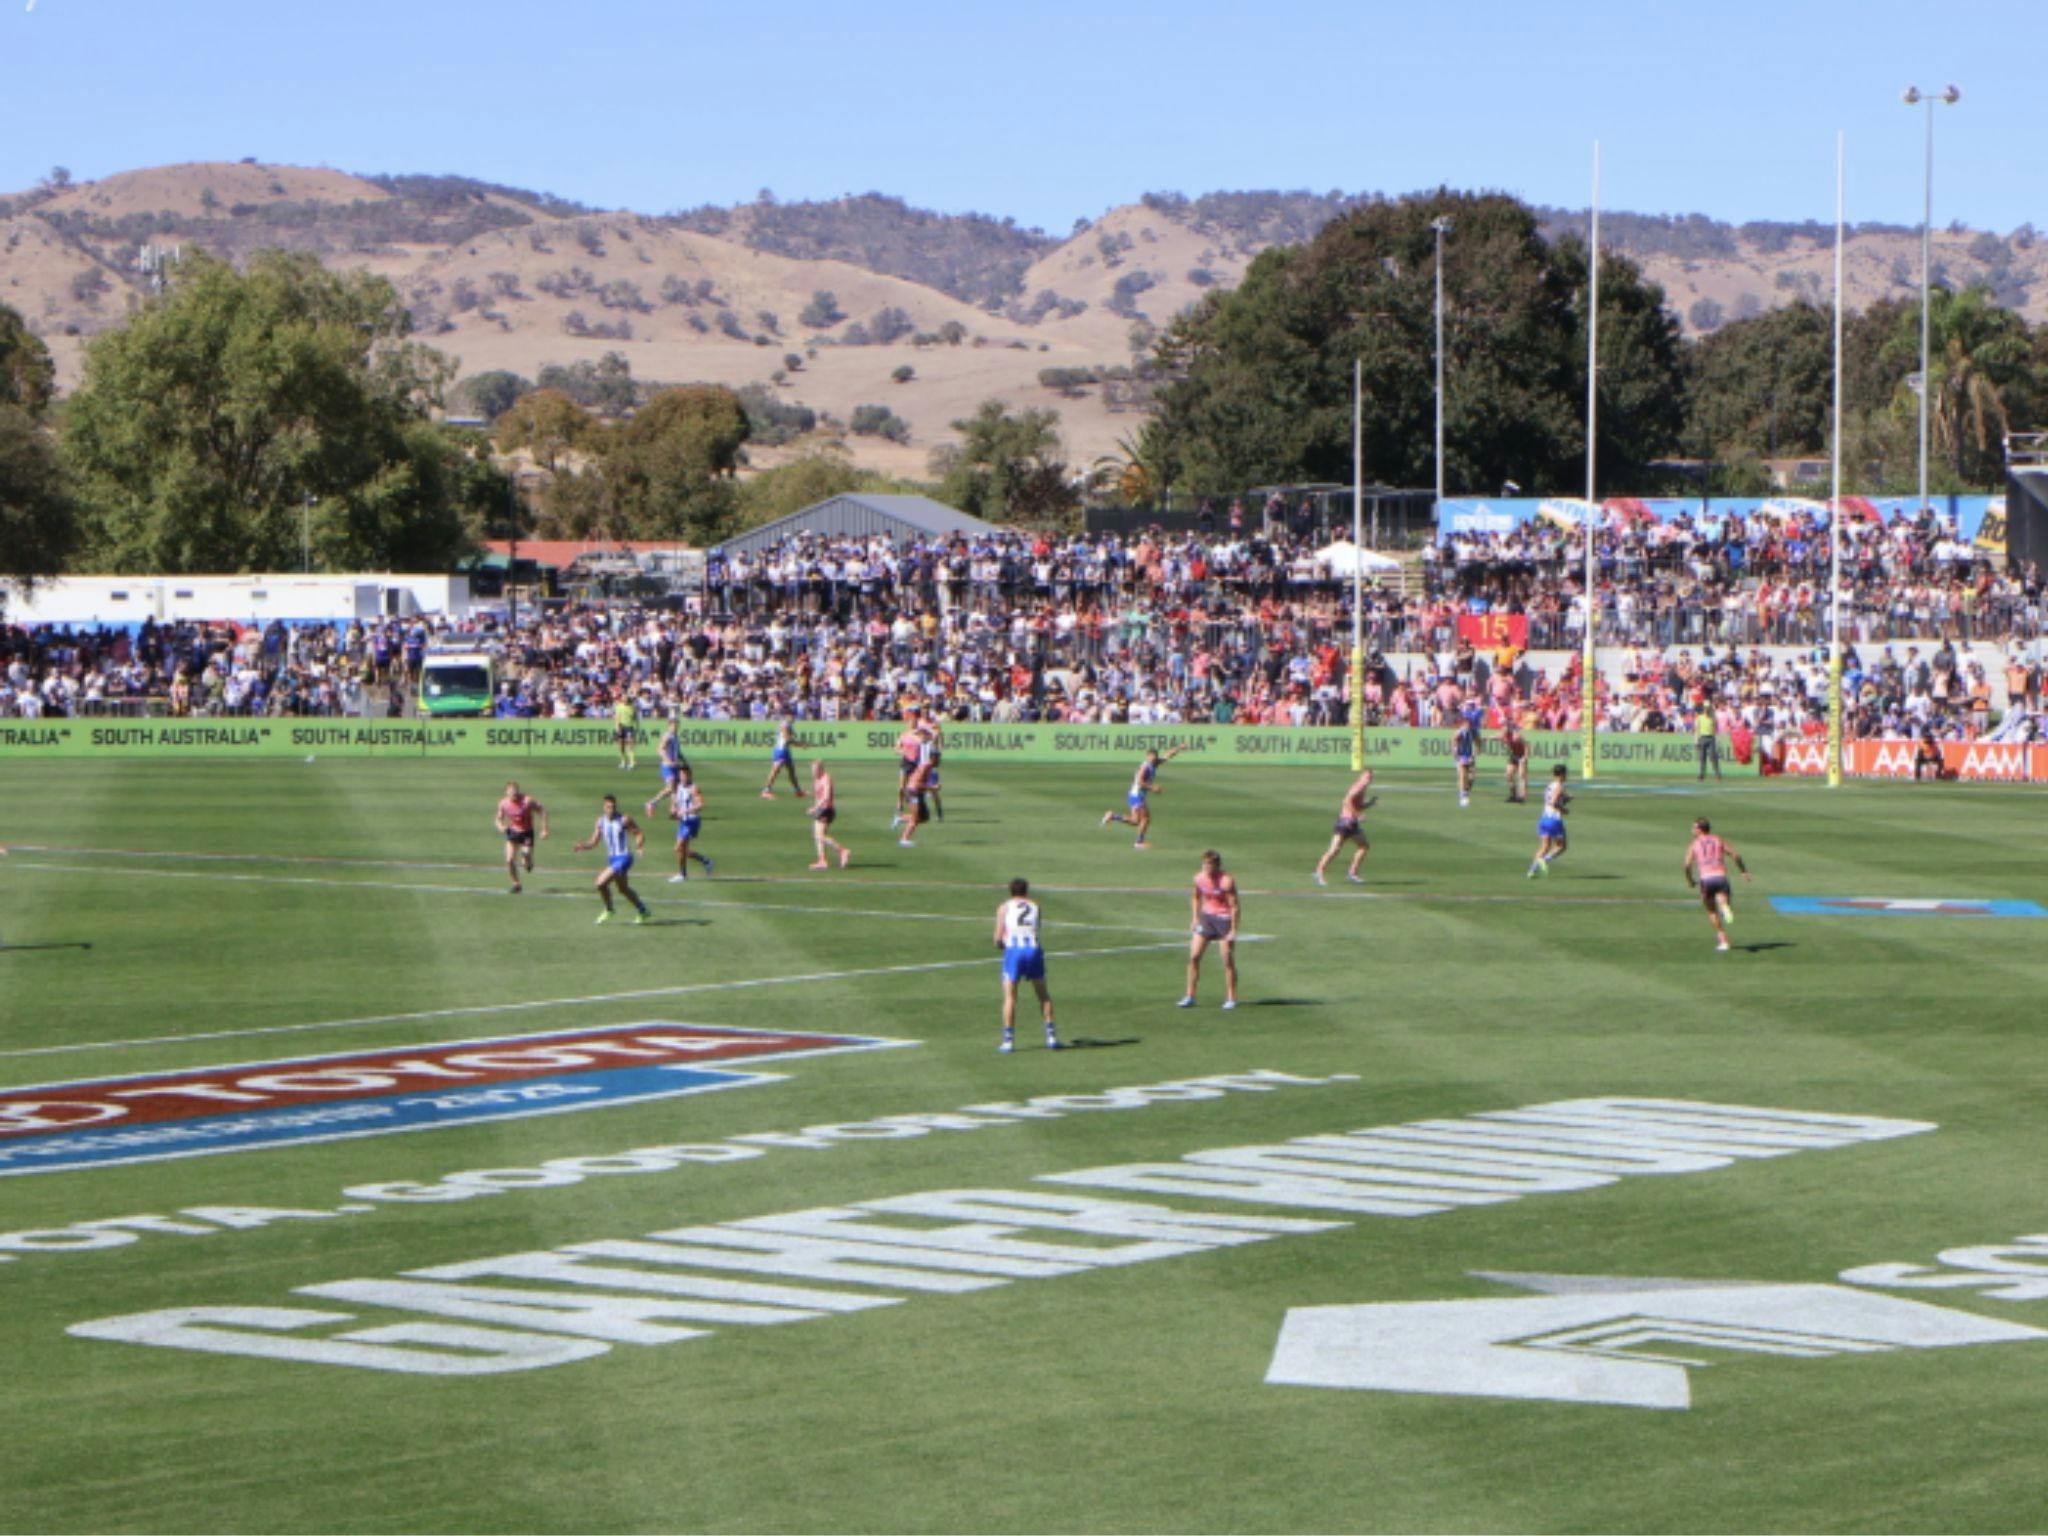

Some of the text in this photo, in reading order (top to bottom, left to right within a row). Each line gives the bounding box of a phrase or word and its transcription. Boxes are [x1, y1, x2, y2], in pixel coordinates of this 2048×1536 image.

[92, 728, 260, 745] SOUTH AUSTRALIA
[292, 728, 457, 746] SOUTH AUSTRALIA
[486, 728, 546, 745] SOUTH
[681, 729, 737, 746] SOUTH
[1054, 733, 1109, 750] SOUTH
[1235, 735, 1291, 753] SOUTH
[1600, 741, 1656, 761] SOUTH
[1016, 902, 1032, 926] 2
[104, 1036, 795, 1101] TOYOTA
[341, 1143, 767, 1203] GOOD
[723, 1112, 1026, 1149] FOR
[64, 1096, 1938, 1377] GATHER ROUND
